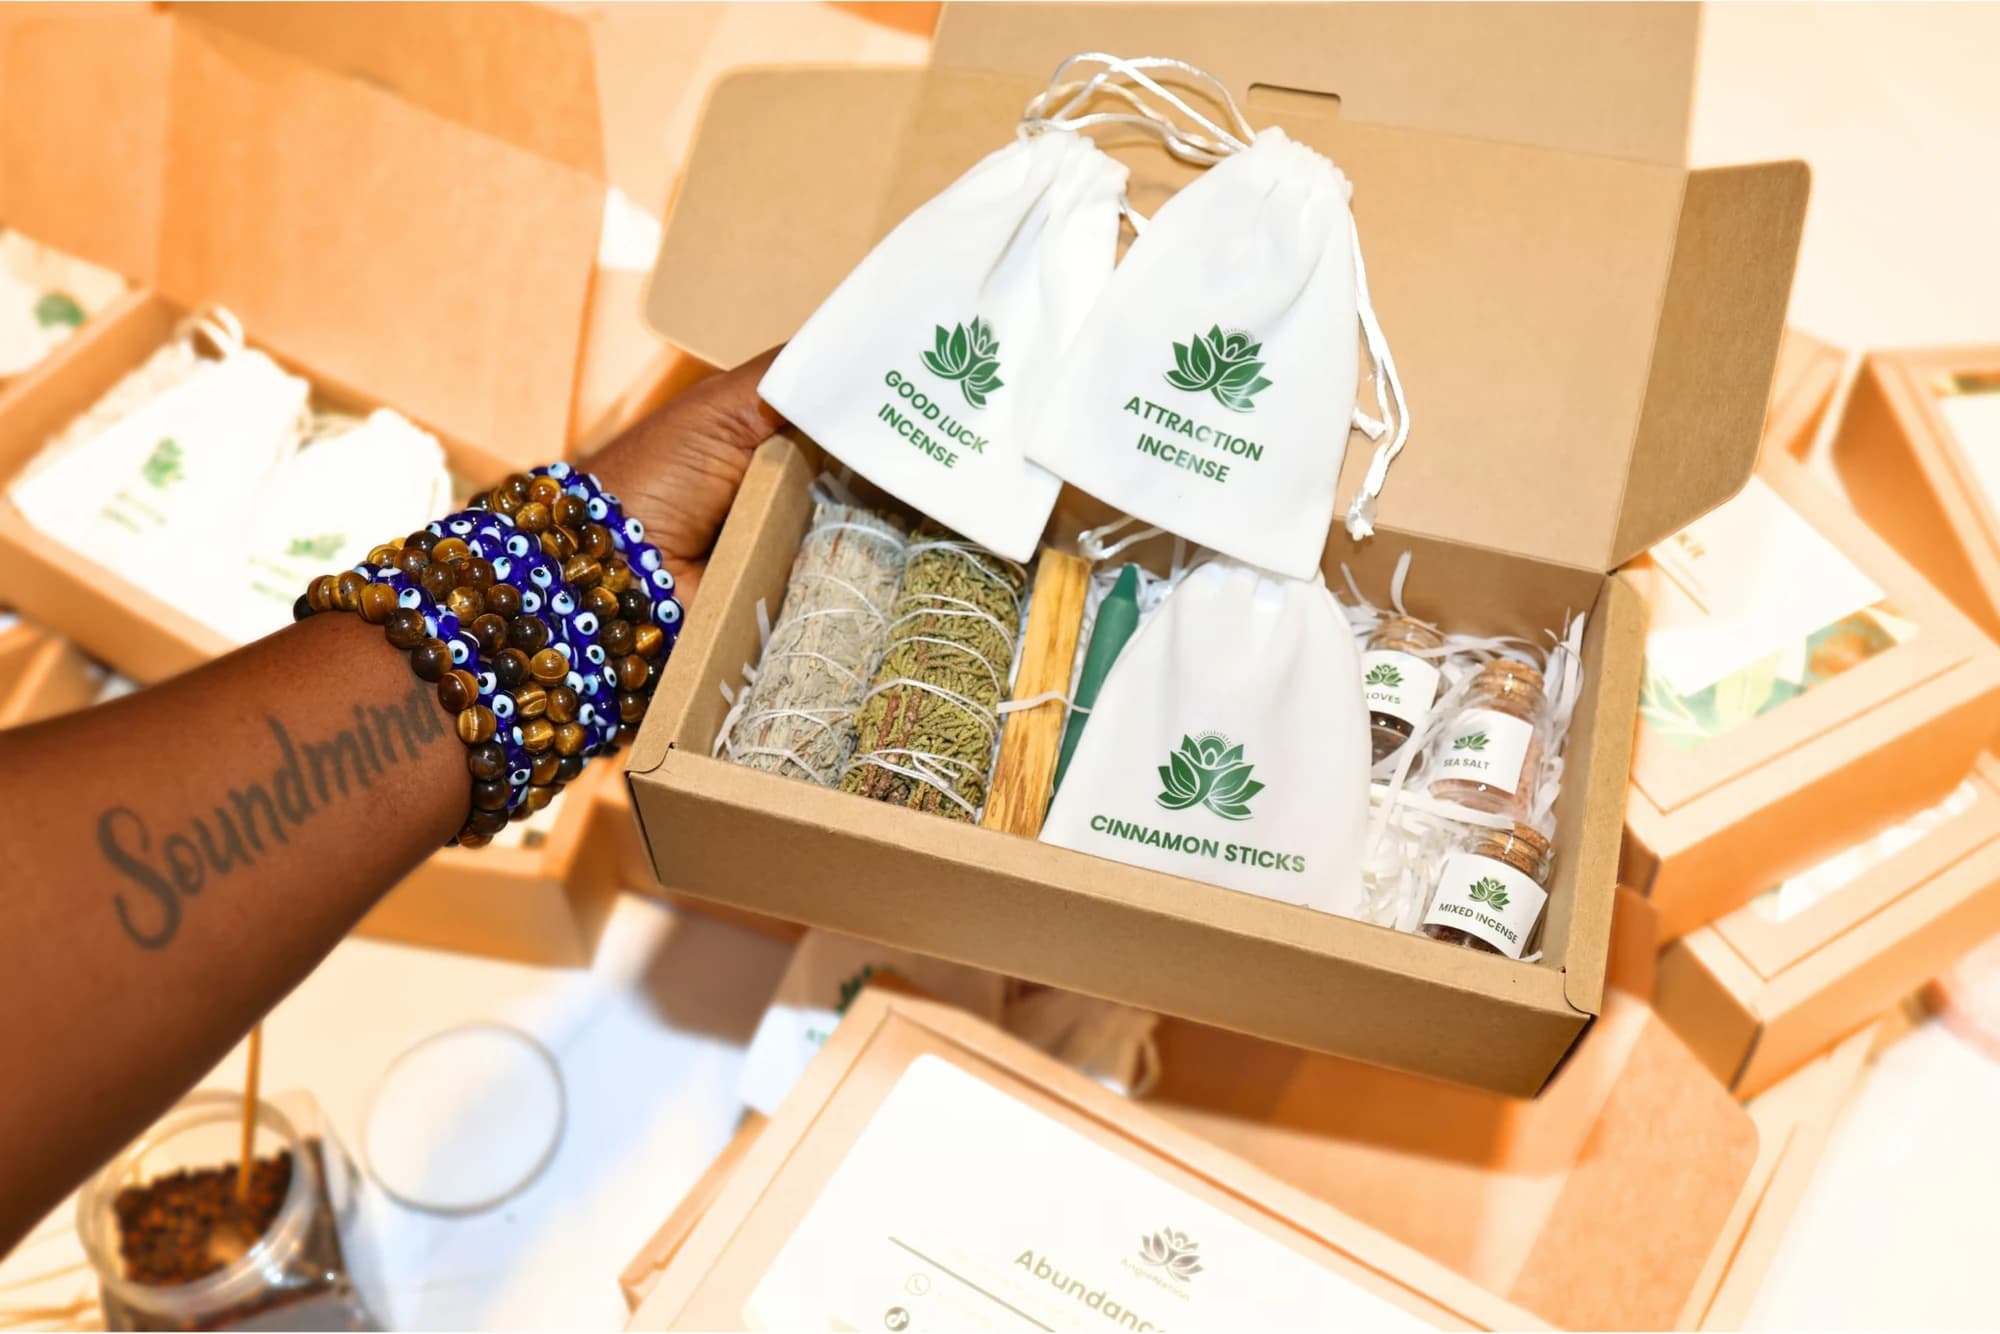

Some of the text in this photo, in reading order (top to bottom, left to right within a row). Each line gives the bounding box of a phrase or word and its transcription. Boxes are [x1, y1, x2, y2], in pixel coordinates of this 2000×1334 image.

[878, 403, 959, 469] INCENSE
[884, 370, 990, 455] GOOD LUCK
[1123, 396, 1264, 462] ATTRACTION
[1136, 433, 1231, 483] INCENSE
[1366, 691, 1401, 705] LOVES
[1443, 757, 1491, 771] SEA SALT
[1090, 815, 1306, 873] CINNAMON STICKS
[1438, 902, 1519, 945] MIXED INCENSE
[1014, 1249, 1166, 1333] Abundanc
